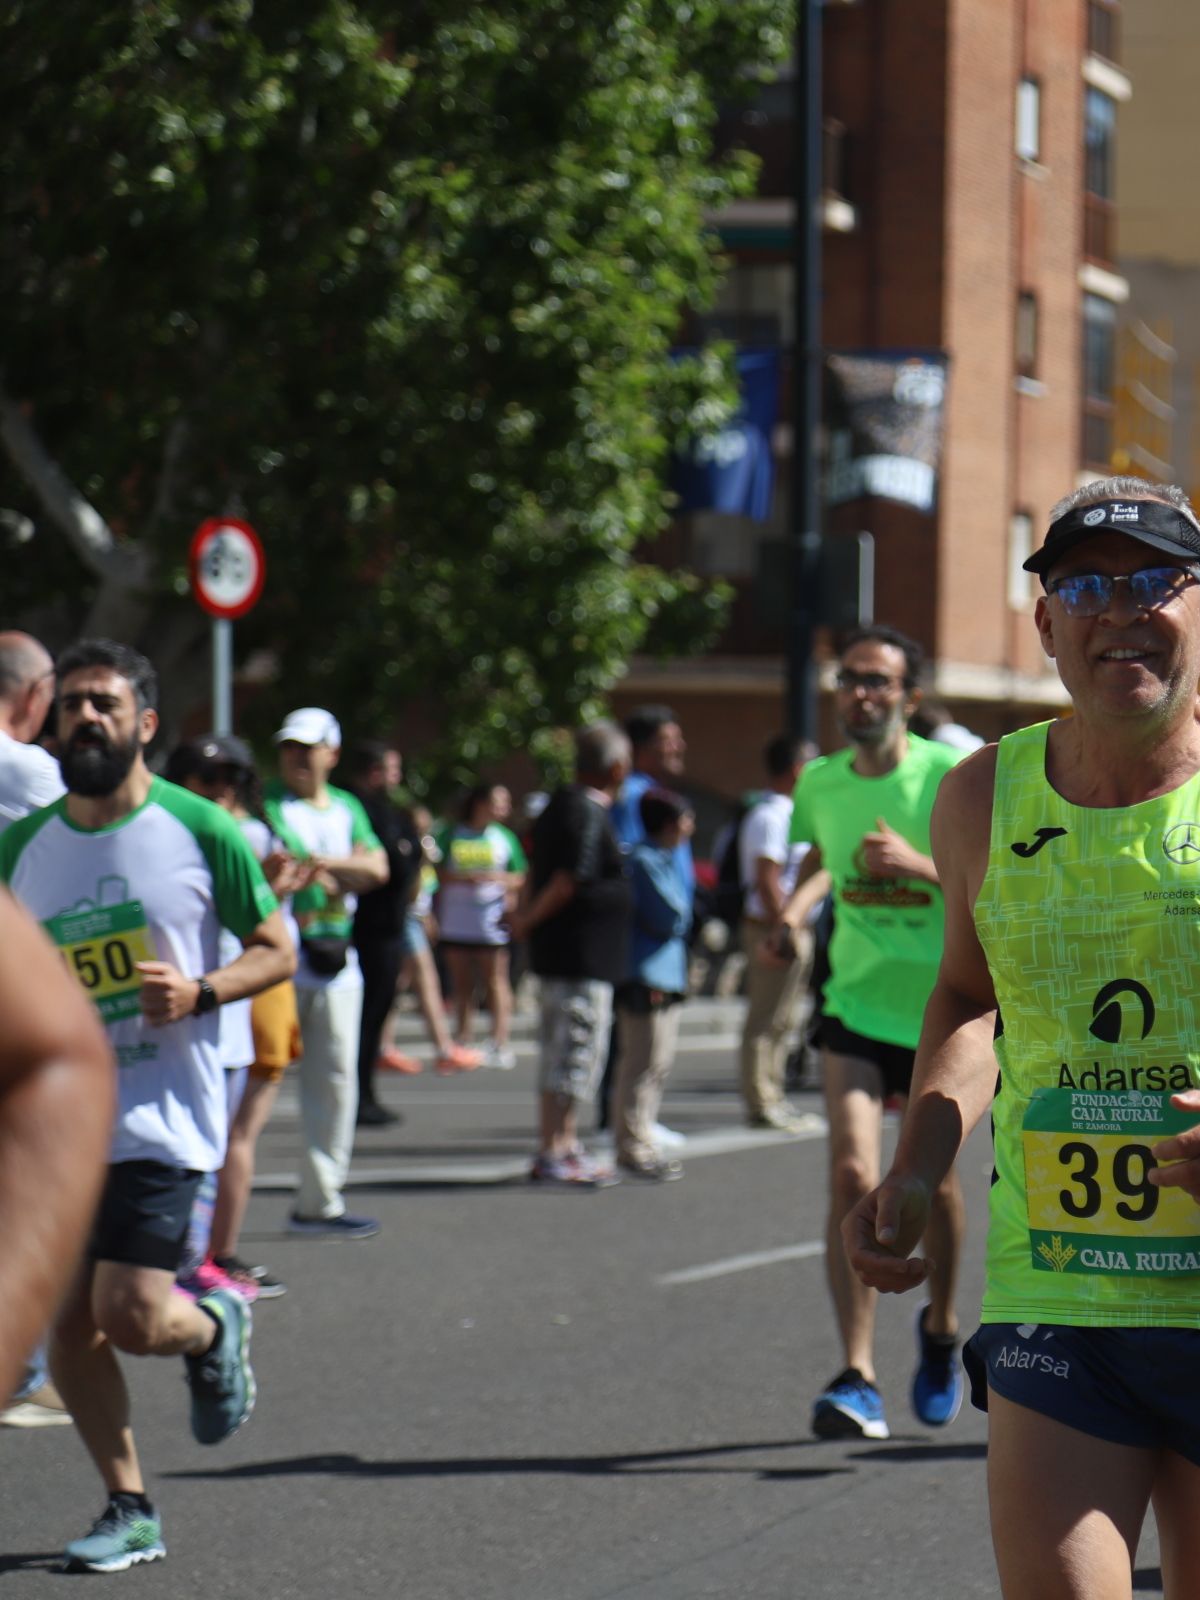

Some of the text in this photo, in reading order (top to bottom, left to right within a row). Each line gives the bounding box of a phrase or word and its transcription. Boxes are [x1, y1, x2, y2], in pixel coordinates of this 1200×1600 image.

[73, 940, 134, 988] 50
[1057, 1061, 1193, 1091] Adarsa
[1071, 1107, 1163, 1122] CAJA RURAL
[1072, 1122, 1122, 1131] DE ZAMORA
[1058, 1141, 1159, 1221] 39
[1080, 1248, 1131, 1271] CAJA
[996, 1346, 1070, 1379] Adarsa
